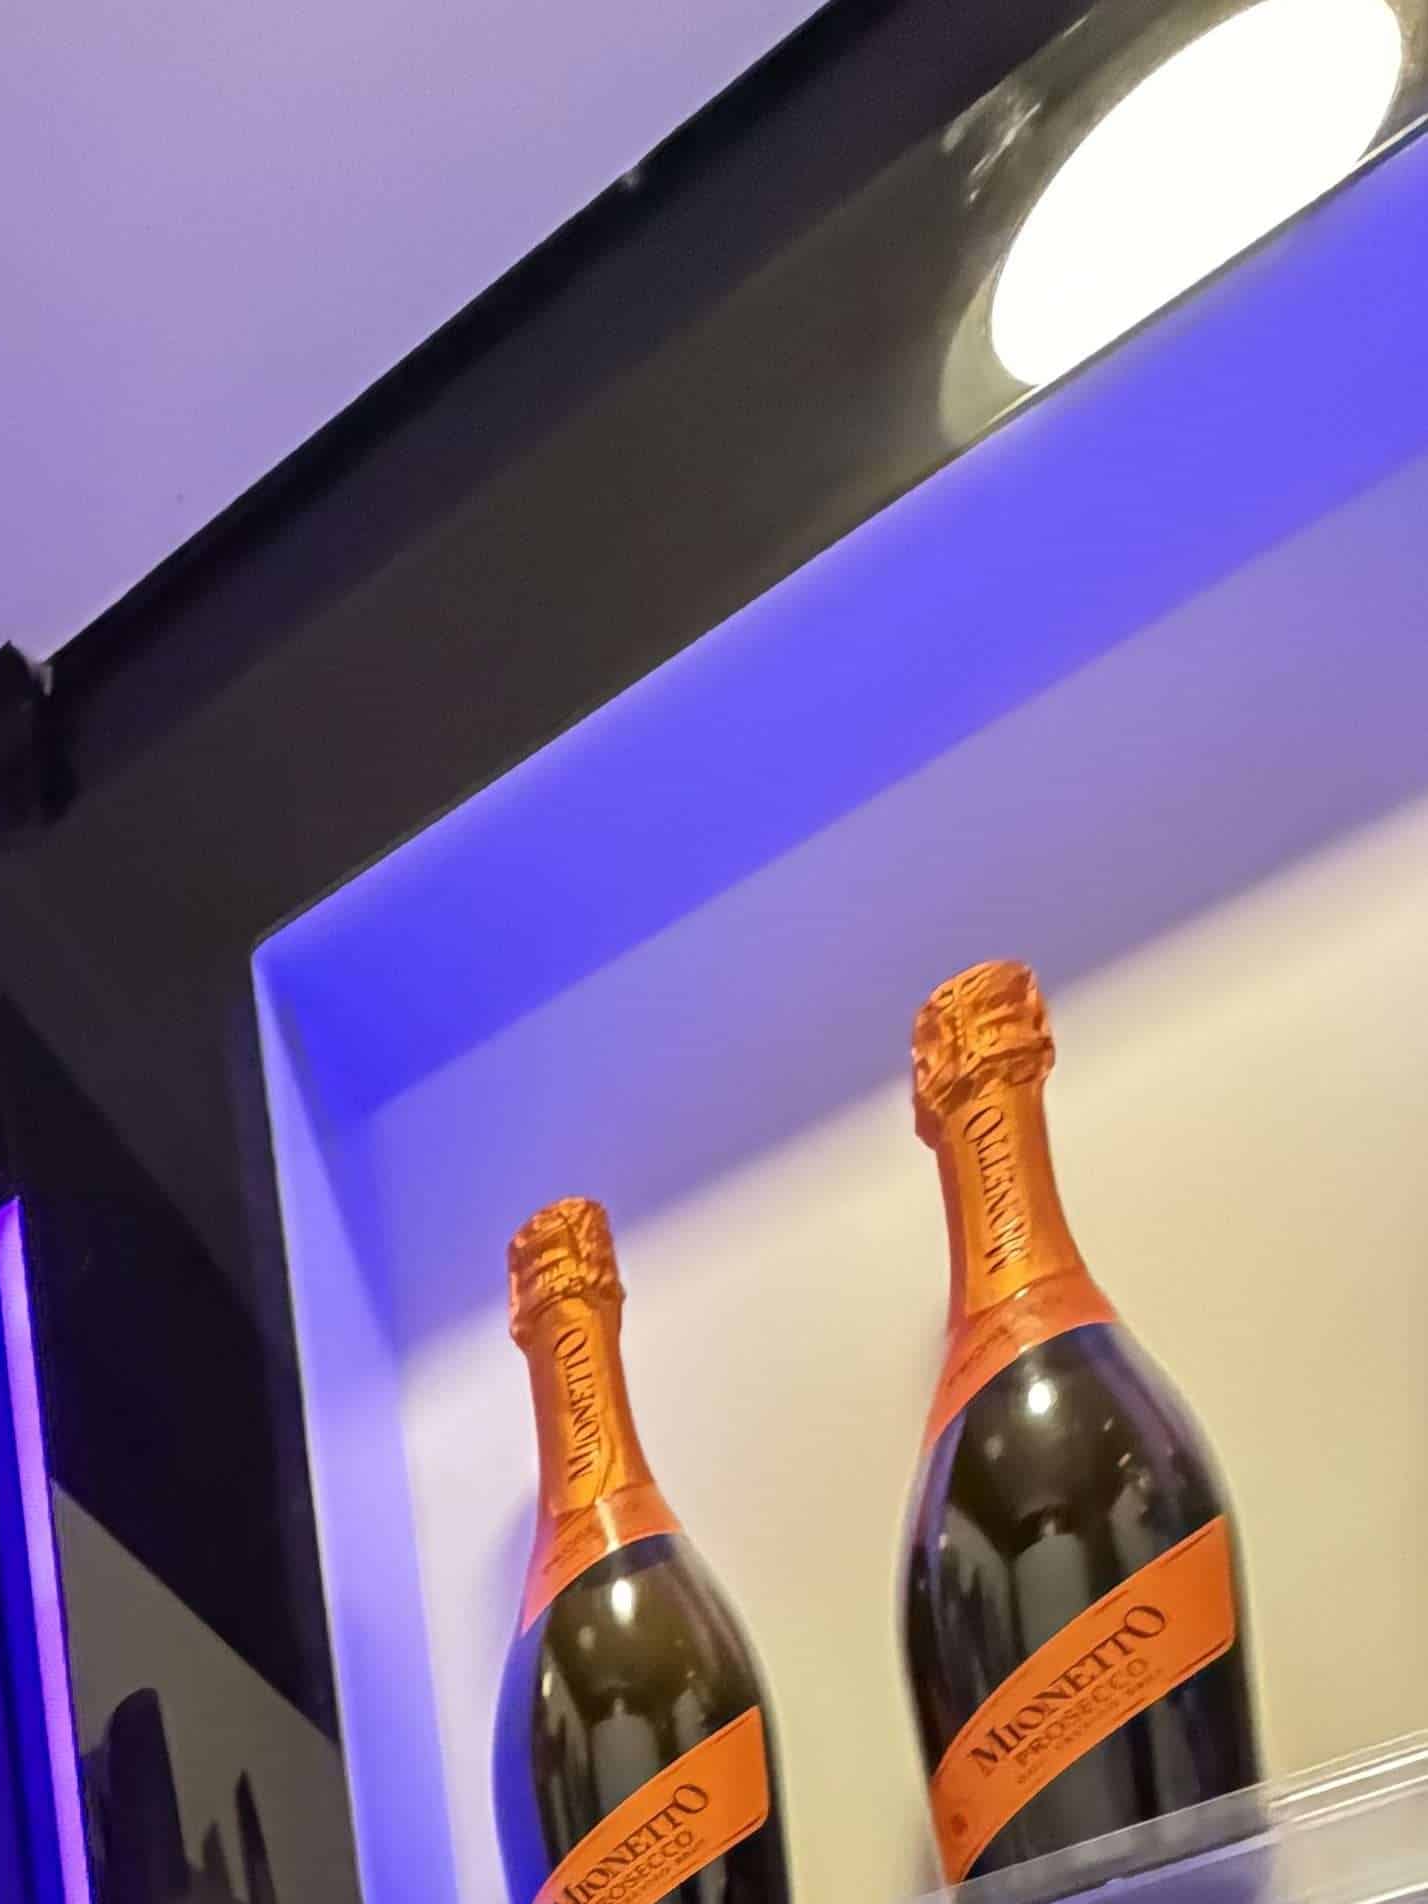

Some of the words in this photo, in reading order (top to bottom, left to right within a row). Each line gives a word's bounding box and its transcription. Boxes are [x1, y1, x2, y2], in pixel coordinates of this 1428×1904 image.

[552, 1326, 601, 1483] MIONETTO
[967, 1604, 1166, 1777] MIONETTO
[1014, 1658, 1149, 1766] PROSECCO
